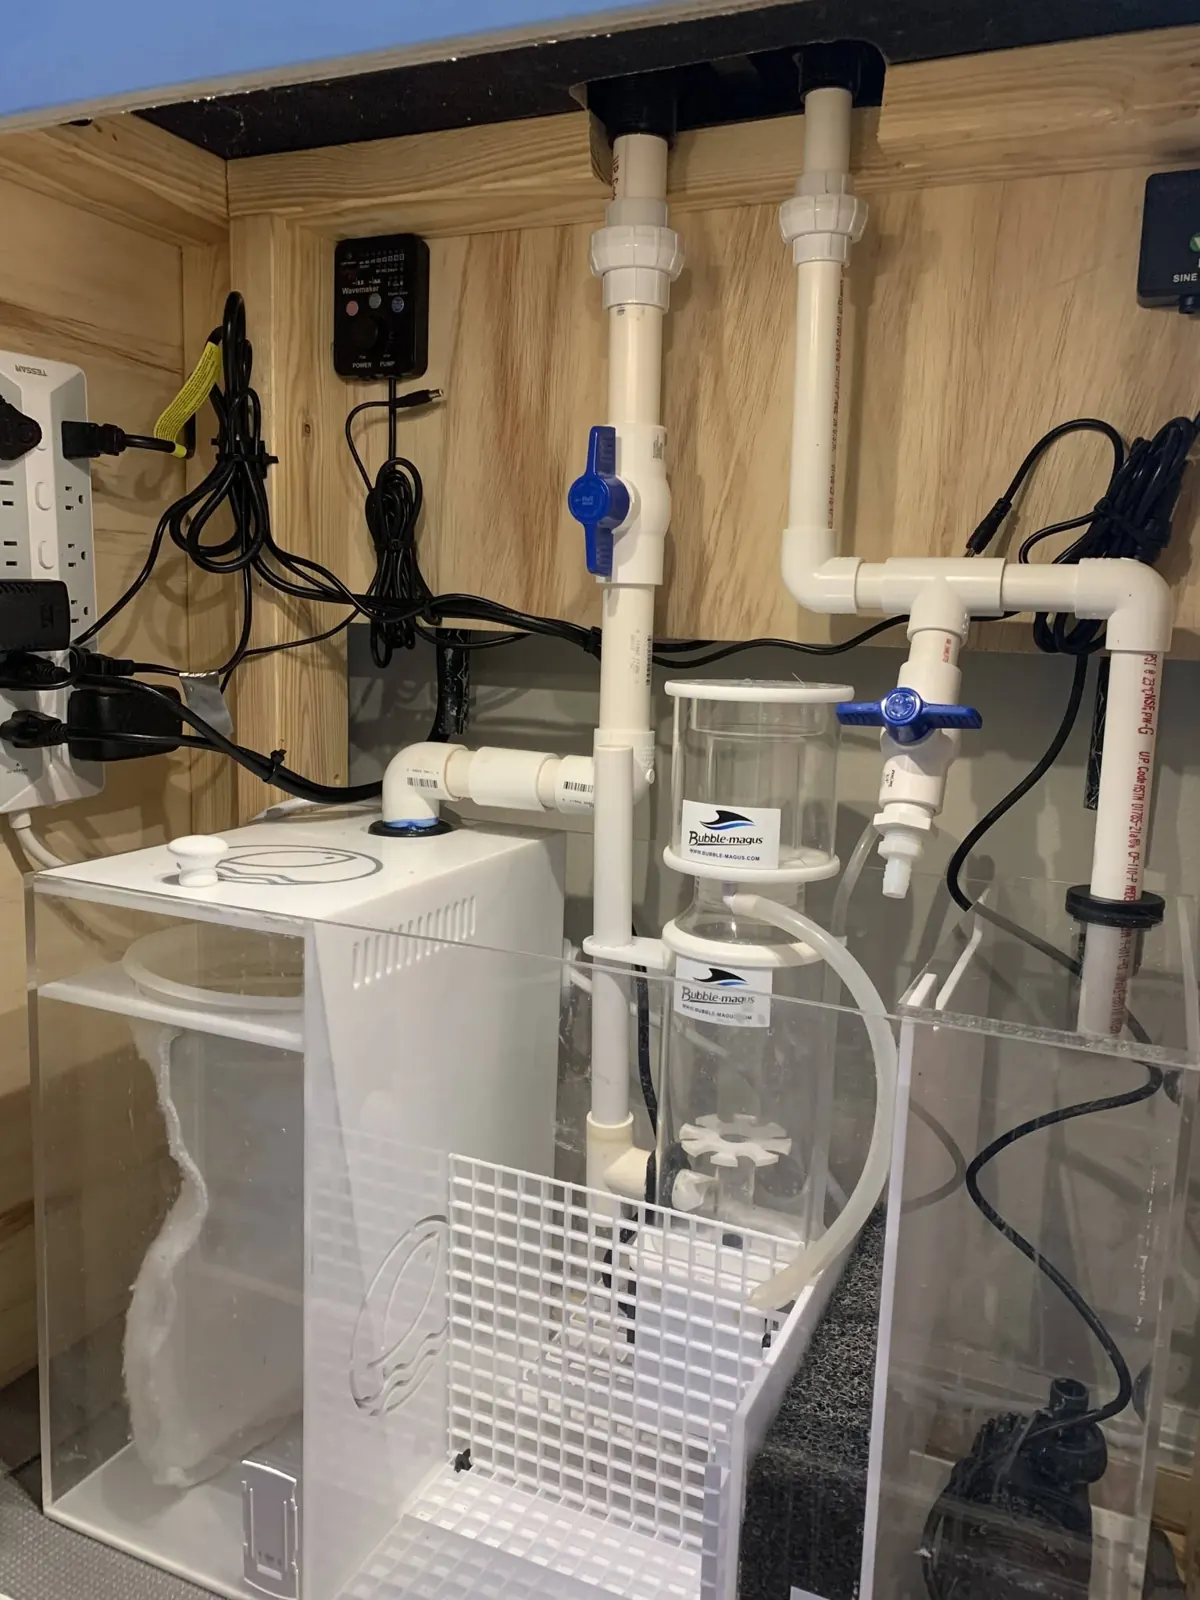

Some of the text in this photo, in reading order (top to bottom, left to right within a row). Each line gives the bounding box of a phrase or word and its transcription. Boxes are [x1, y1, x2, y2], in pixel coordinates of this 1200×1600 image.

[1172, 273, 1198, 284] SINE
[341, 285, 380, 295] Wavemaker
[15, 363, 48, 377] TESSAN
[1142, 653, 1159, 666] PSI
[1135, 766, 1150, 784] Code
[689, 848, 761, 862] WWW.BUBBLE-MAGUS.COM
